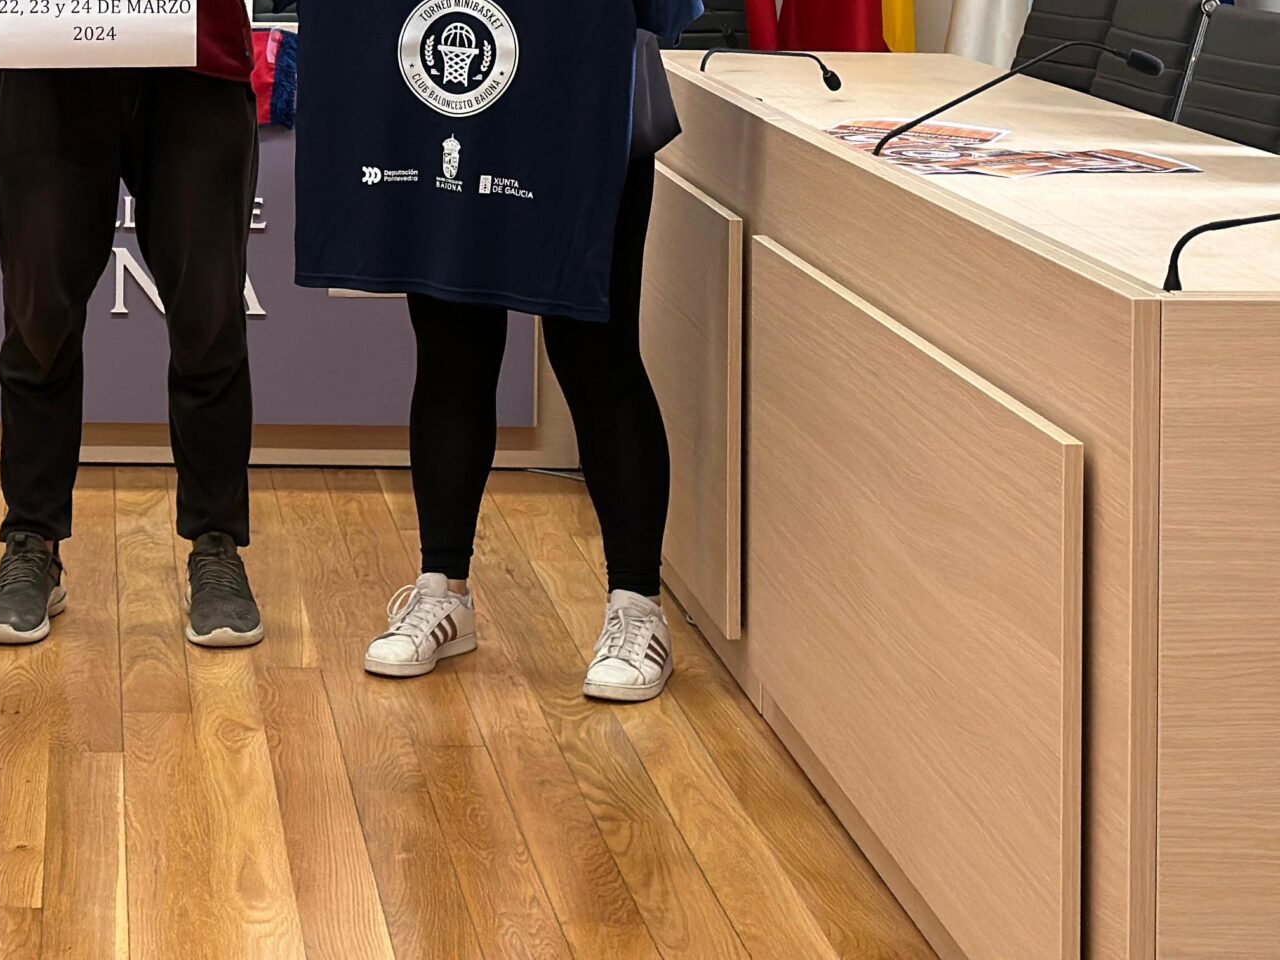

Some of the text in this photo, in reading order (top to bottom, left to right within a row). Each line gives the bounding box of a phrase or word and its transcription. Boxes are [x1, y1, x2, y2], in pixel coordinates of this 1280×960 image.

[29, 0, 50, 14] 23
[55, 2, 66, 18] y
[70, 0, 92, 14] 24
[97, 0, 121, 14] DE
[127, 0, 192, 15] MARZO
[73, 26, 117, 41] 2024
[411, 73, 502, 111] CLUB BALONCESTO BAIONA
[436, 182, 463, 192] BAIONA
[493, 177, 519, 188] XUNTA
[492, 185, 534, 200] DE GALICIA
